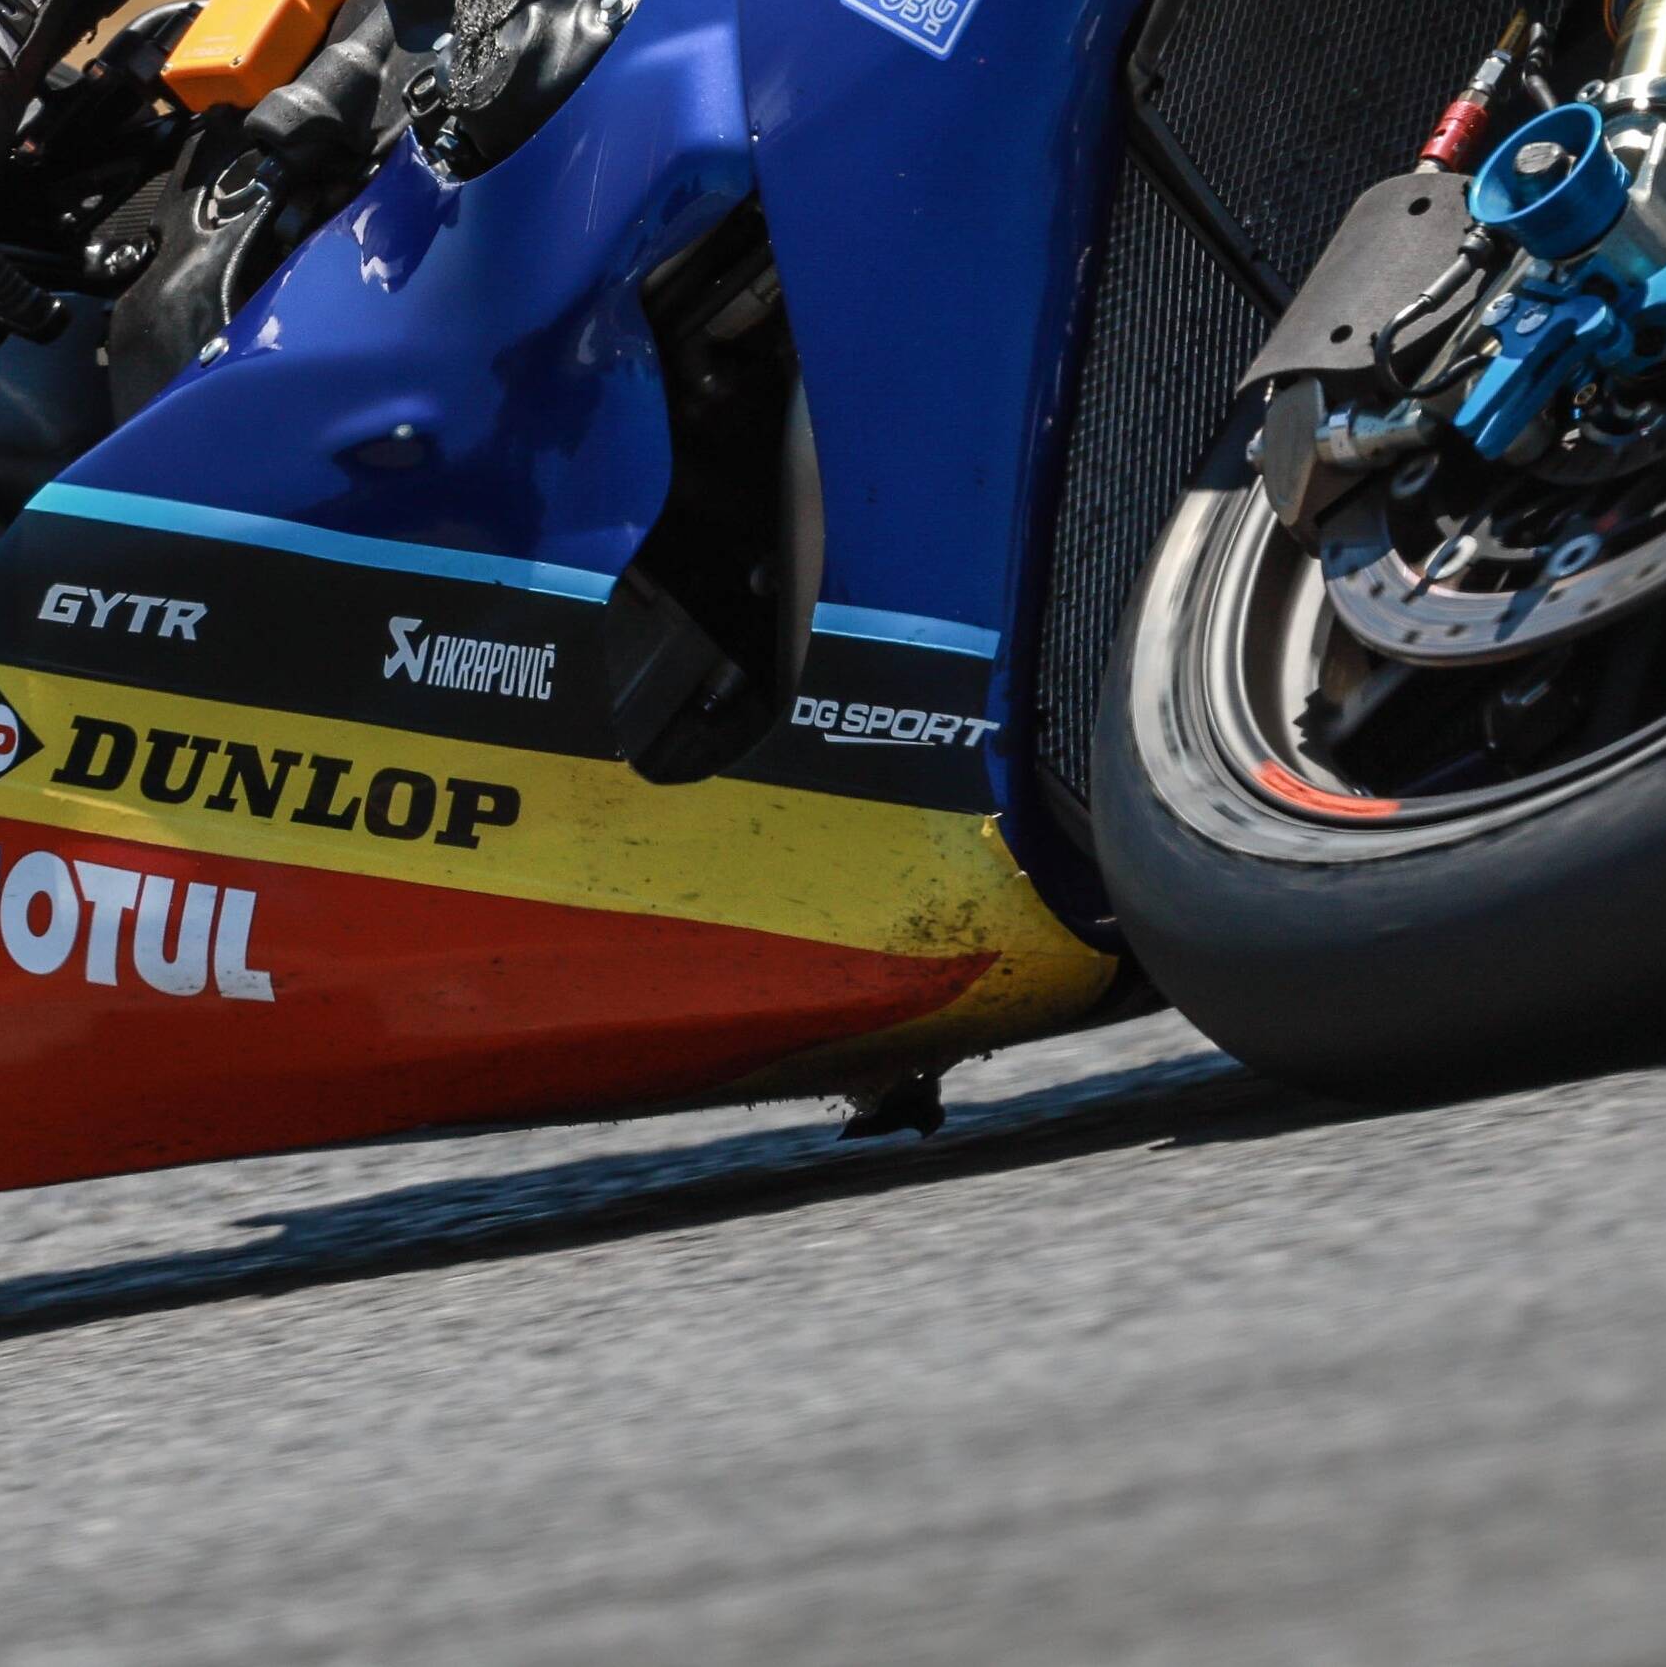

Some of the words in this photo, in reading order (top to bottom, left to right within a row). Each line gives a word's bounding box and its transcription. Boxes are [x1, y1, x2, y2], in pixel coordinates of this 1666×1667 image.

[37, 582, 208, 642] GYTR
[426, 635, 556, 701] AKRAPOVIČ
[791, 695, 840, 729] DG
[840, 702, 1001, 748] SPORT
[51, 715, 521, 850] DUNLOP
